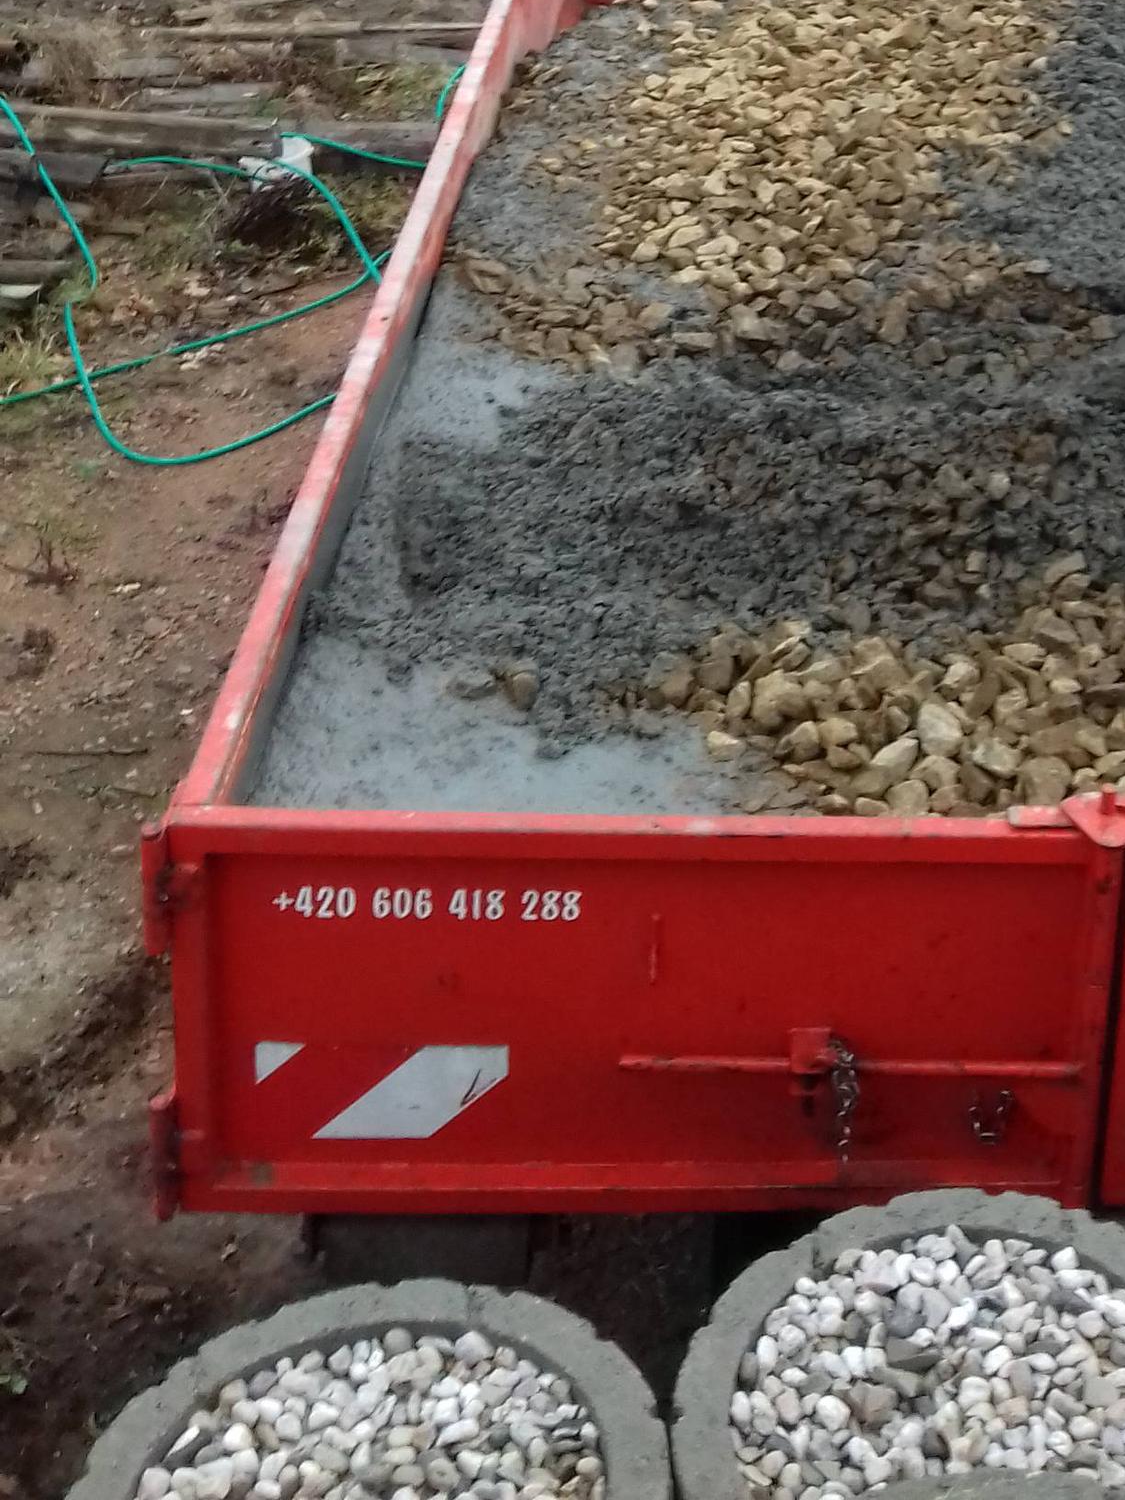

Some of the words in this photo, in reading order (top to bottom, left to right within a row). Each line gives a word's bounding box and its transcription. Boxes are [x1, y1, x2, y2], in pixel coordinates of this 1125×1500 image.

[272, 886, 357, 918] +420
[372, 887, 434, 920] 606
[448, 888, 506, 921] 418
[521, 889, 583, 922] 288
